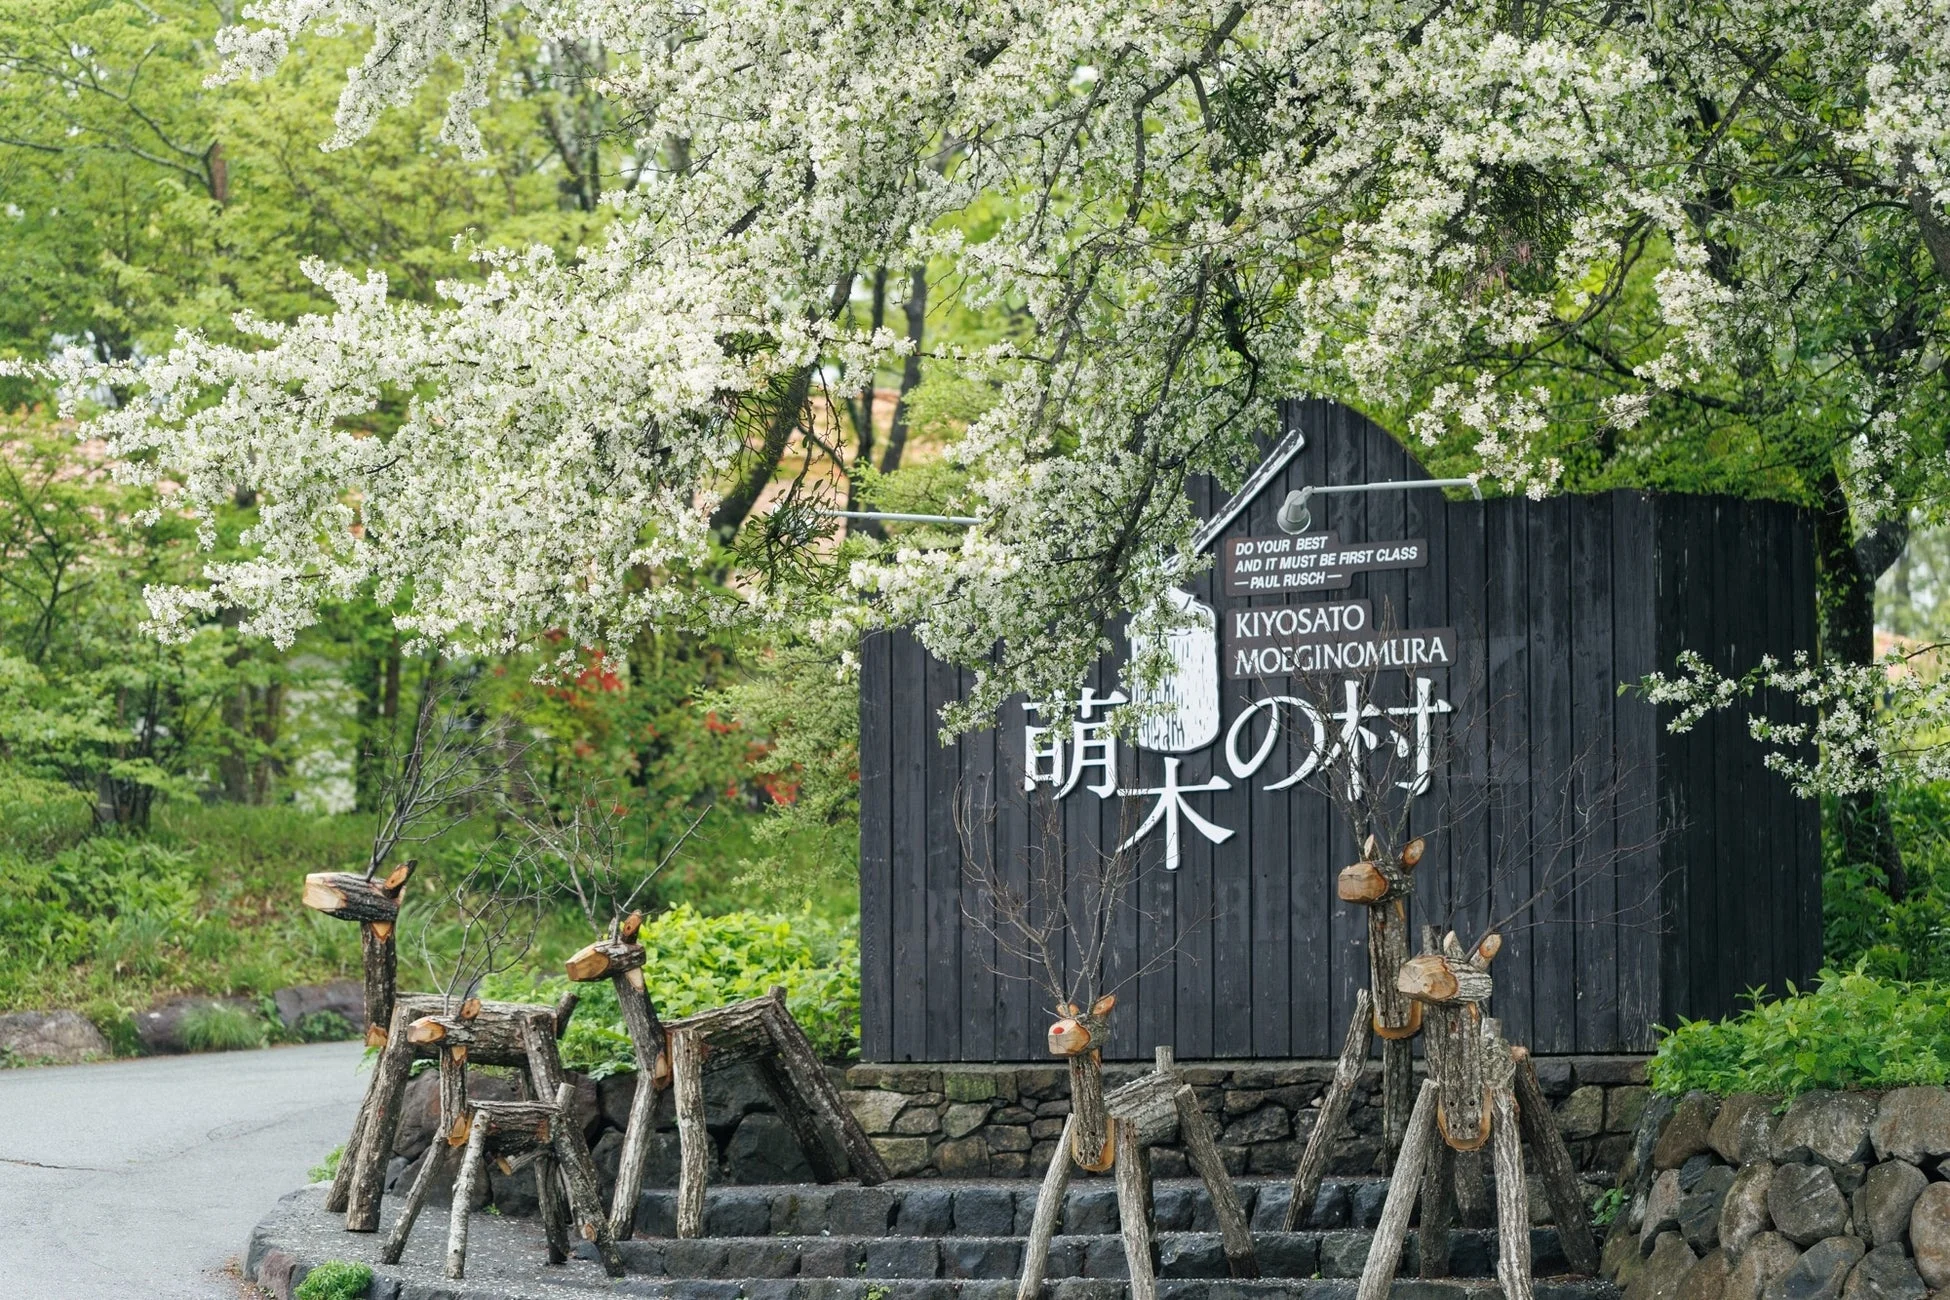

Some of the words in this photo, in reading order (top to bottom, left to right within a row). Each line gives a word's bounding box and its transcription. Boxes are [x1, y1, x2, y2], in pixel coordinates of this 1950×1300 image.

[1234, 559, 1262, 573] AND
[1265, 557, 1278, 571] IT
[1279, 554, 1317, 570] MUST
[1319, 553, 1337, 567] BE
[1338, 549, 1374, 565] FIRST
[1376, 546, 1418, 562] CLASS
[1235, 542, 1254, 556] DO
[1256, 539, 1291, 554] YOUR
[1295, 536, 1328, 551] BEST
[1235, 604, 1365, 639] KIYOSATO
[1234, 636, 1448, 676] MOEGINOMURA
